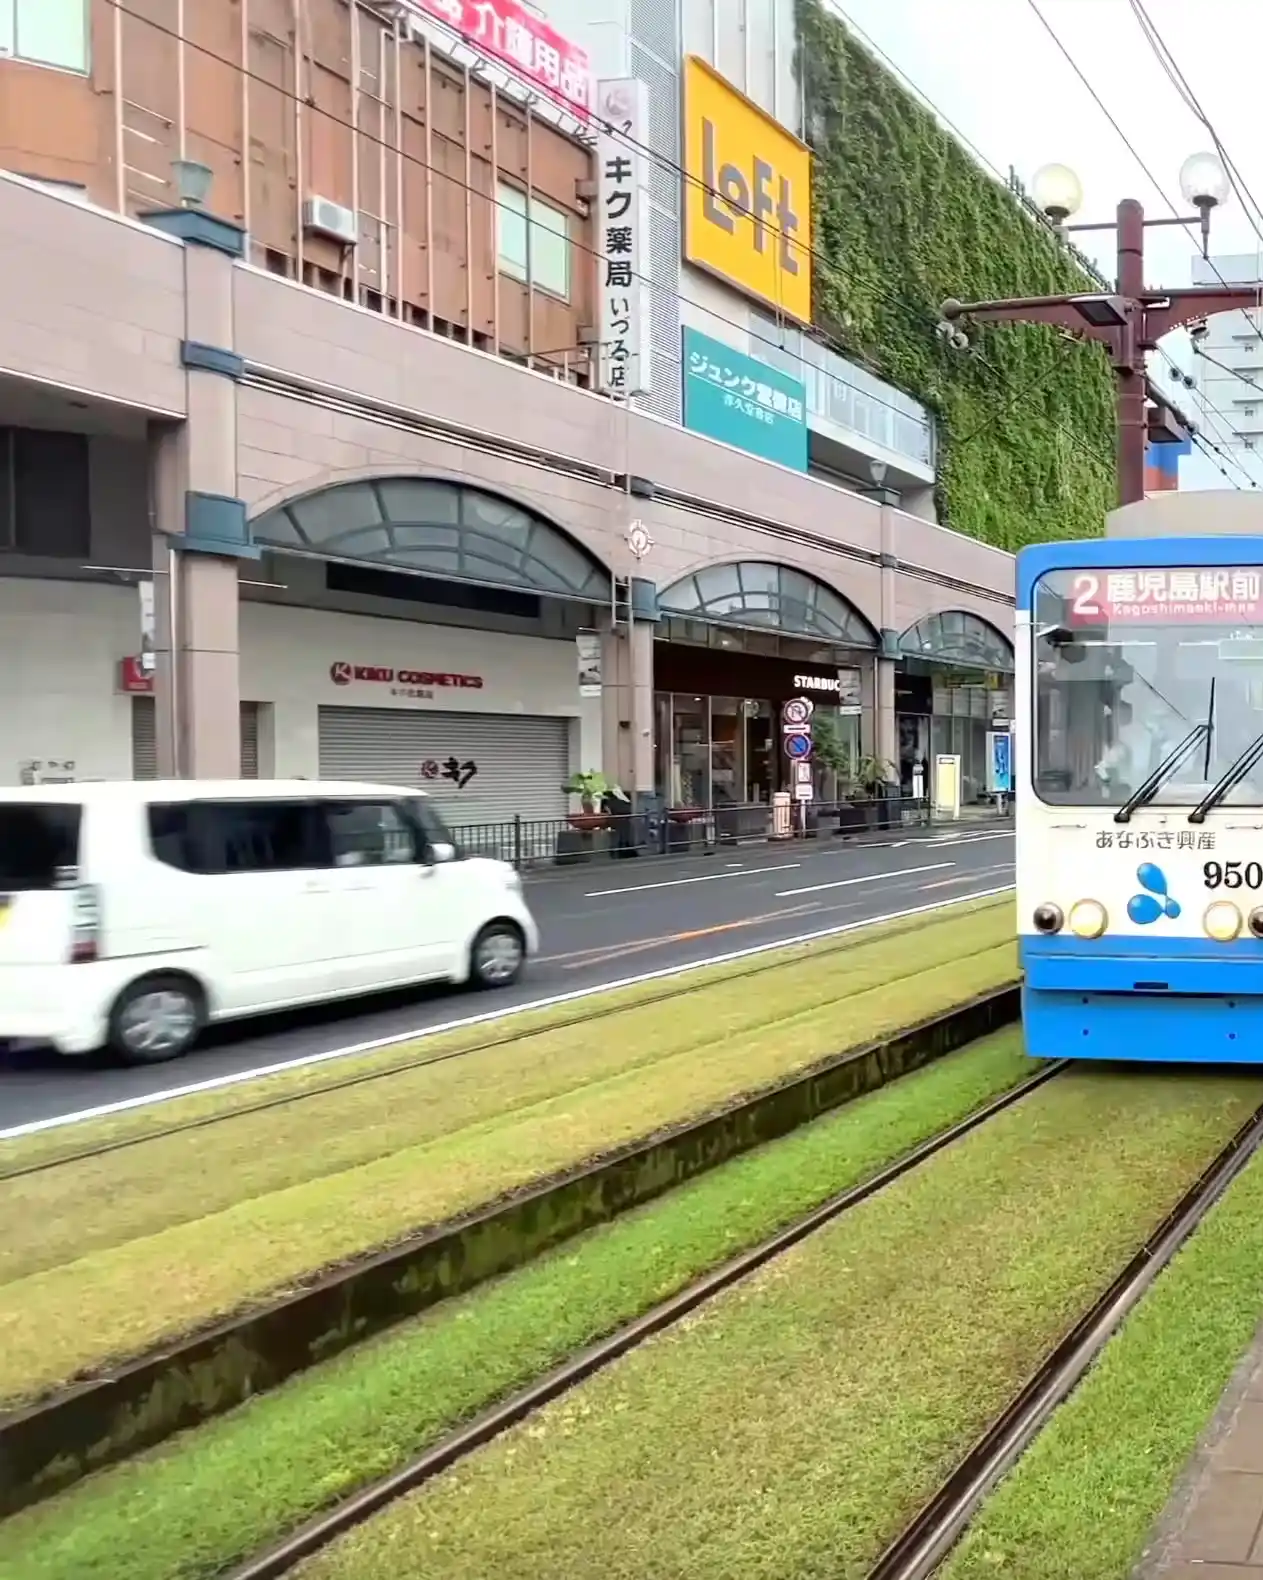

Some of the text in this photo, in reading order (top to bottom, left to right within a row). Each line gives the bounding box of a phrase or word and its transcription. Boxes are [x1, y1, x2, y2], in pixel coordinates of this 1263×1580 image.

[1072, 571, 1261, 616] 2 鹿児島駅前
[1096, 830, 1216, 850] あなぶき興産
